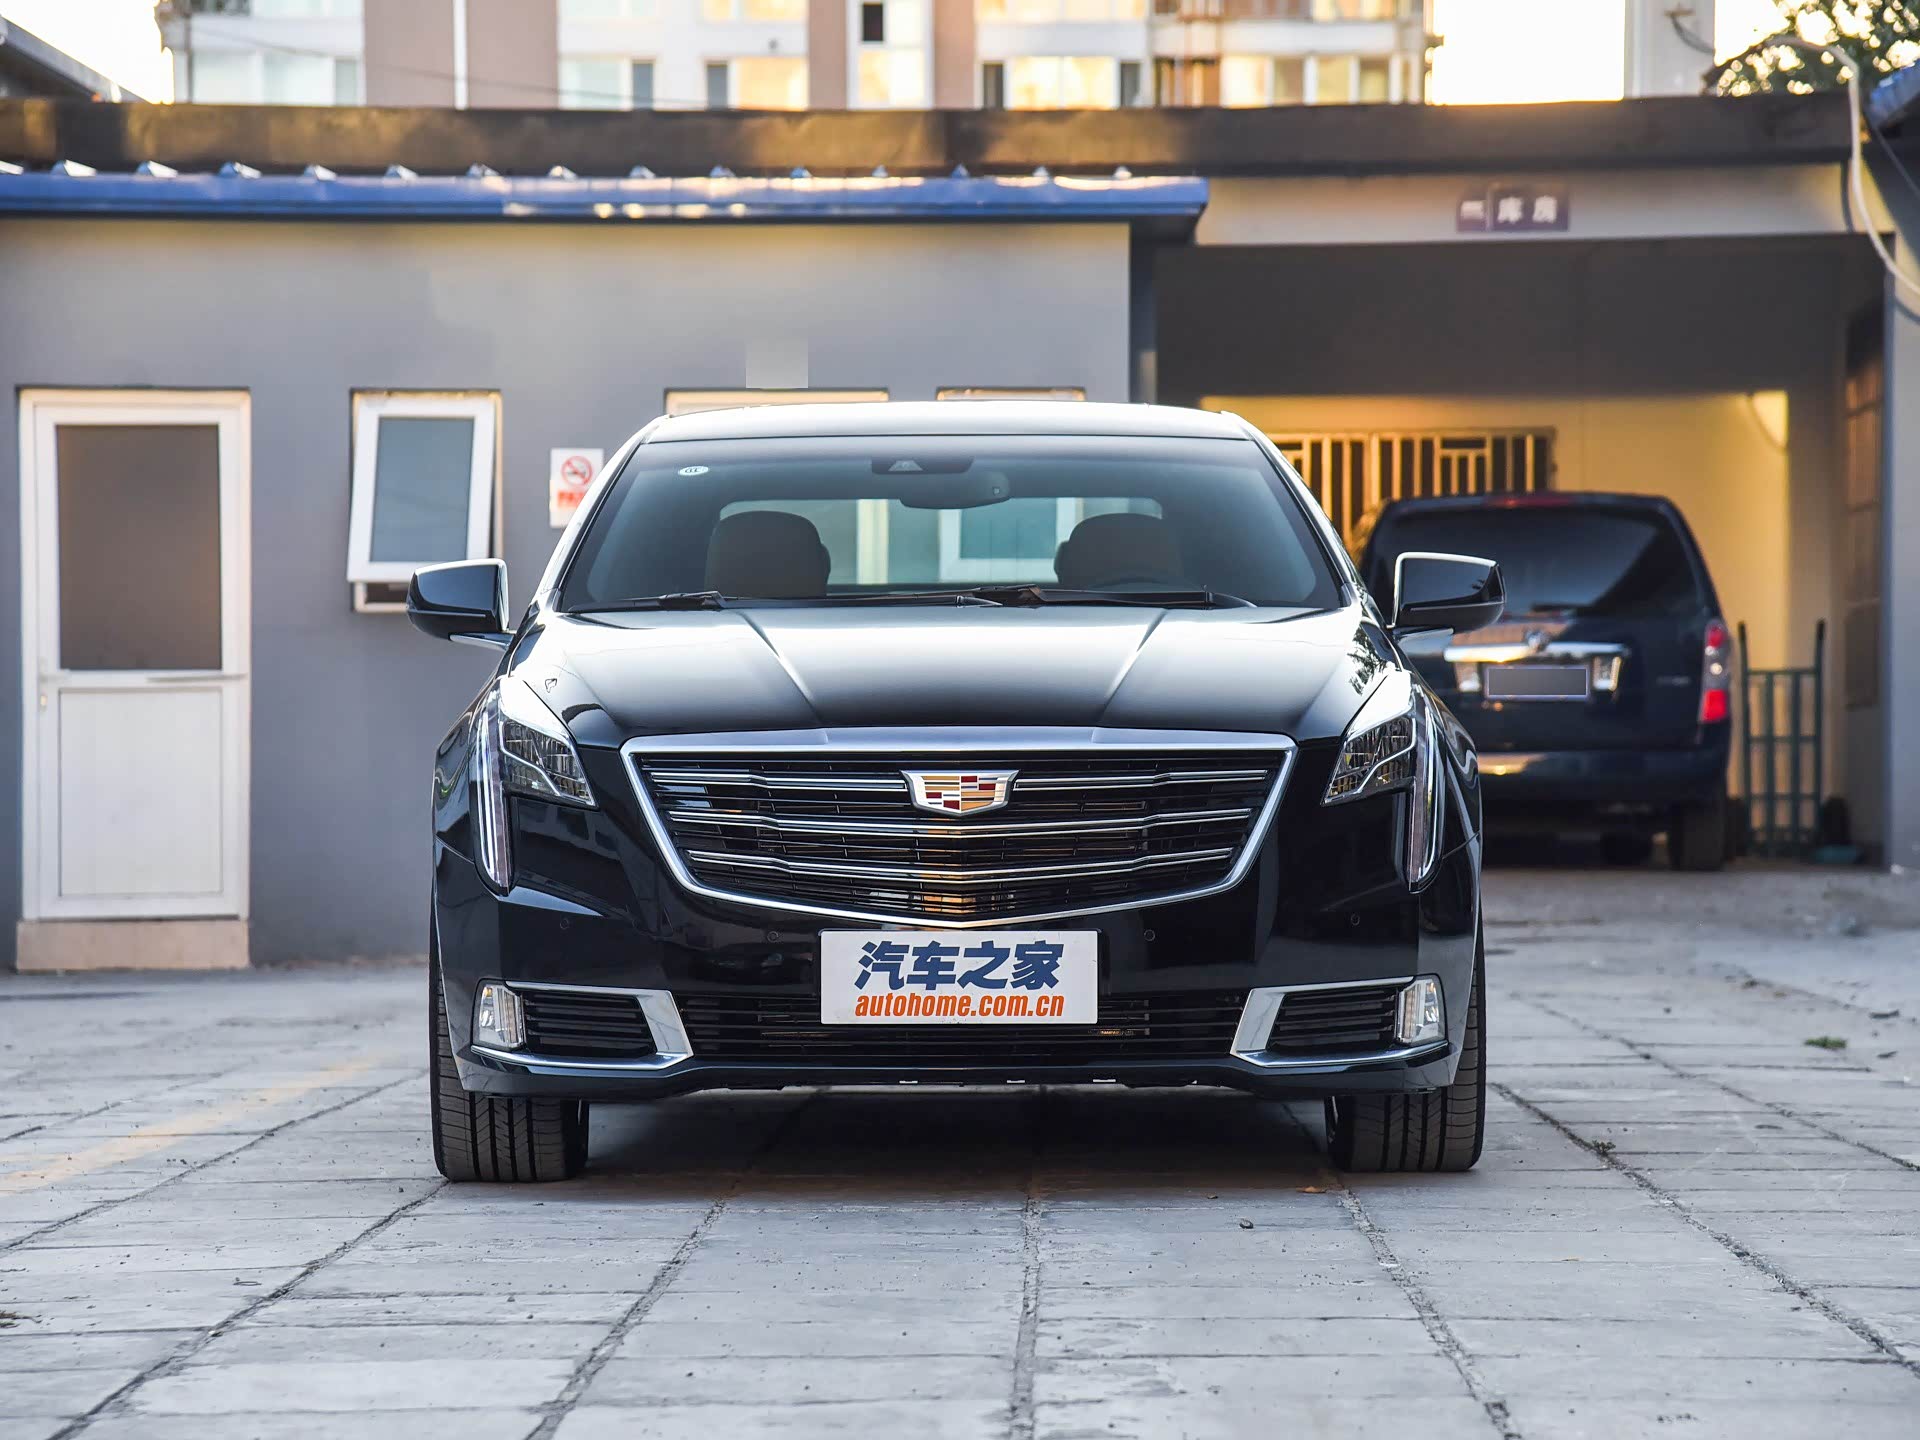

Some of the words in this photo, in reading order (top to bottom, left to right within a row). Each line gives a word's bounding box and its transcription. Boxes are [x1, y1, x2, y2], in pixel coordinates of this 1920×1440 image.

[854, 940, 1064, 990] 汽车之家
[855, 993, 1064, 1017] autohome.com.cn
